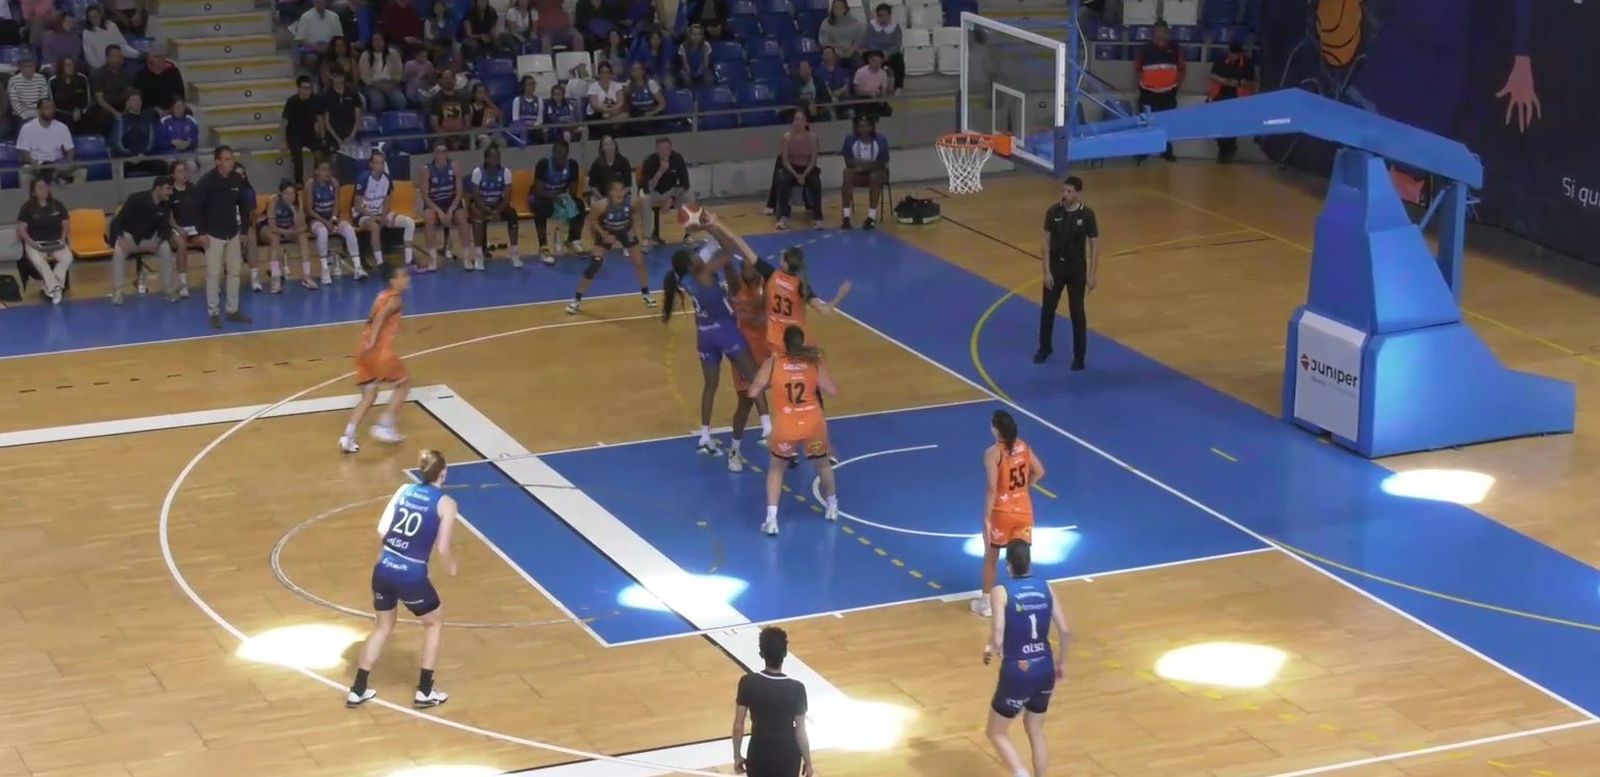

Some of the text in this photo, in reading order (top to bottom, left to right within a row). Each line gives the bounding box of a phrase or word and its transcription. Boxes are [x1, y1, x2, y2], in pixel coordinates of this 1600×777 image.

[1562, 177, 1576, 199] Si
[774, 295, 792, 316] 33
[784, 383, 805, 404] 12
[1009, 465, 1025, 490] 55
[393, 508, 421, 536] 20
[1029, 614, 1038, 638] 1
